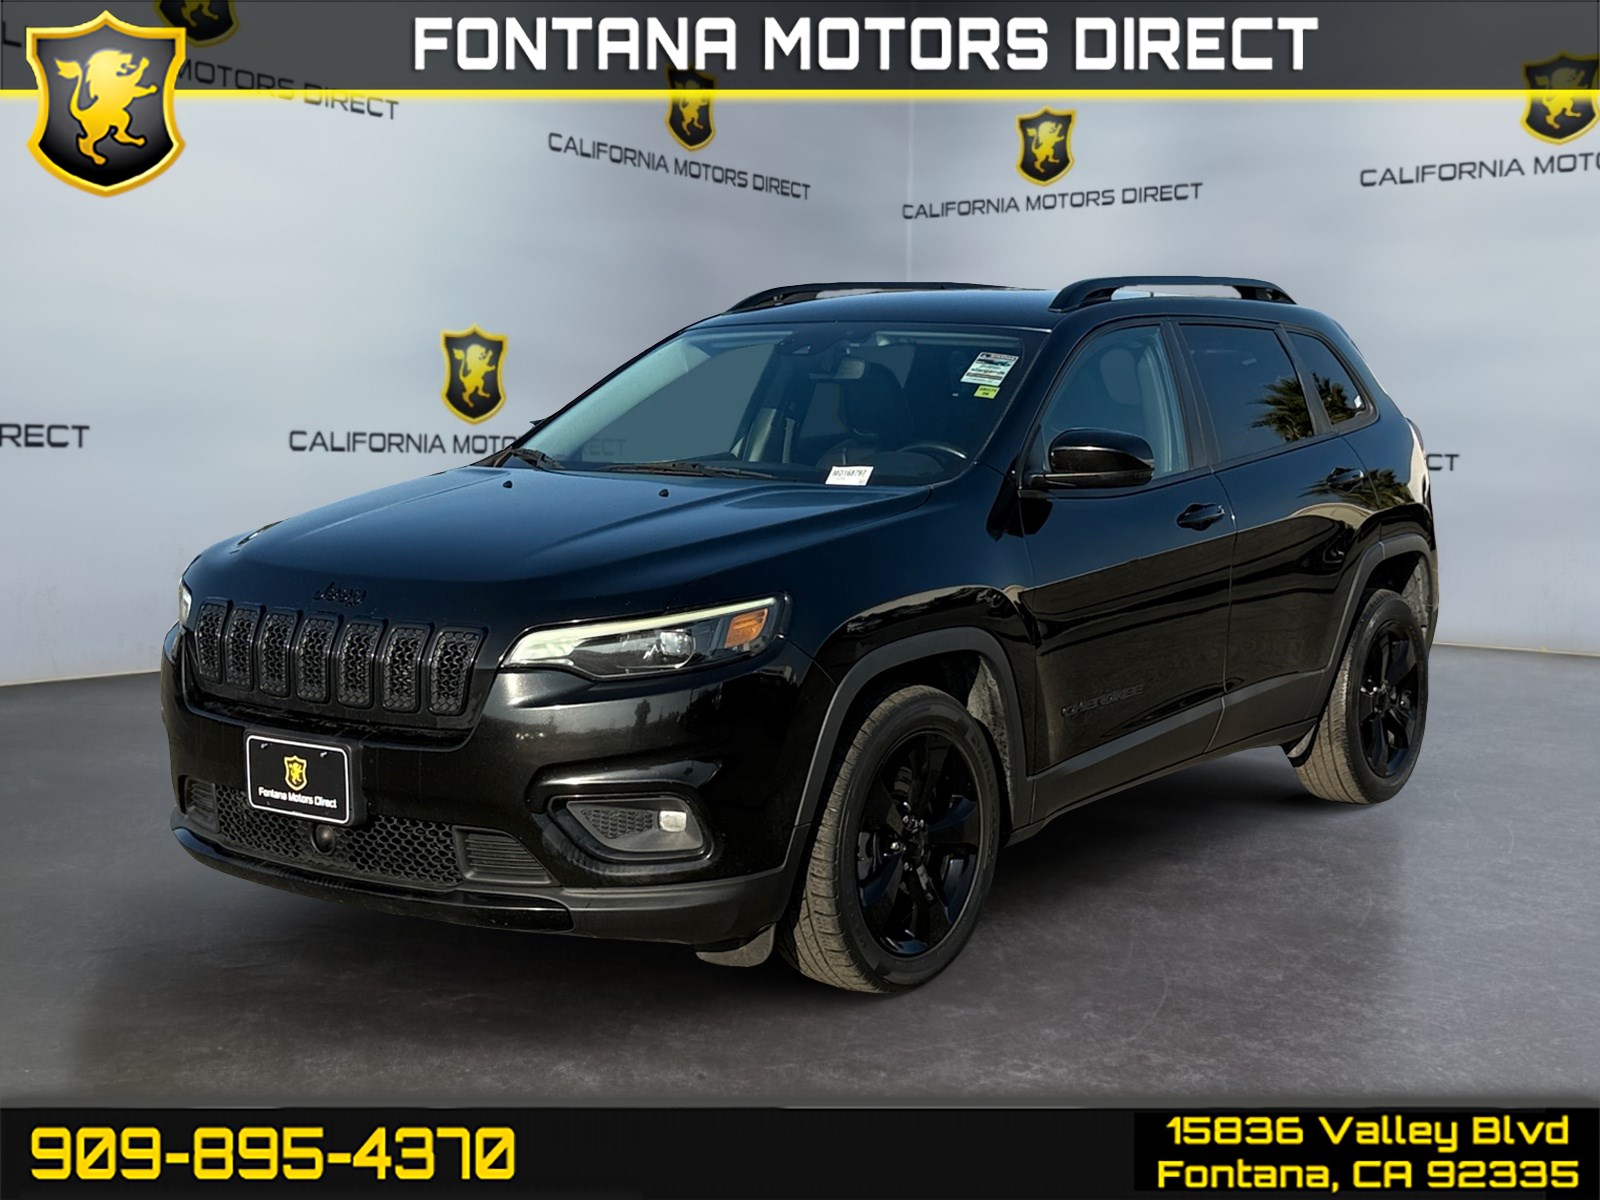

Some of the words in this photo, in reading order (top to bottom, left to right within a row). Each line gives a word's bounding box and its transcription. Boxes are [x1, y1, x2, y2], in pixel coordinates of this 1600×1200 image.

[304, 82, 399, 120] DIRECT
[548, 132, 670, 174] CALIFORNIA
[674, 157, 748, 188] MOTORS
[752, 173, 811, 200] DIRECT
[1359, 158, 1525, 187] CALIFORNIA
[902, 197, 1020, 220] CALIFORNIA
[1026, 189, 1115, 212] MOTORS
[1121, 182, 1204, 204] DIRECT
[0, 423, 90, 448] RECT
[288, 430, 446, 454] CALIFORNIA
[453, 434, 516, 454] MOTO
[258, 786, 287, 801] Fontana
[288, 791, 313, 805] Motors
[314, 796, 337, 809] Direct
